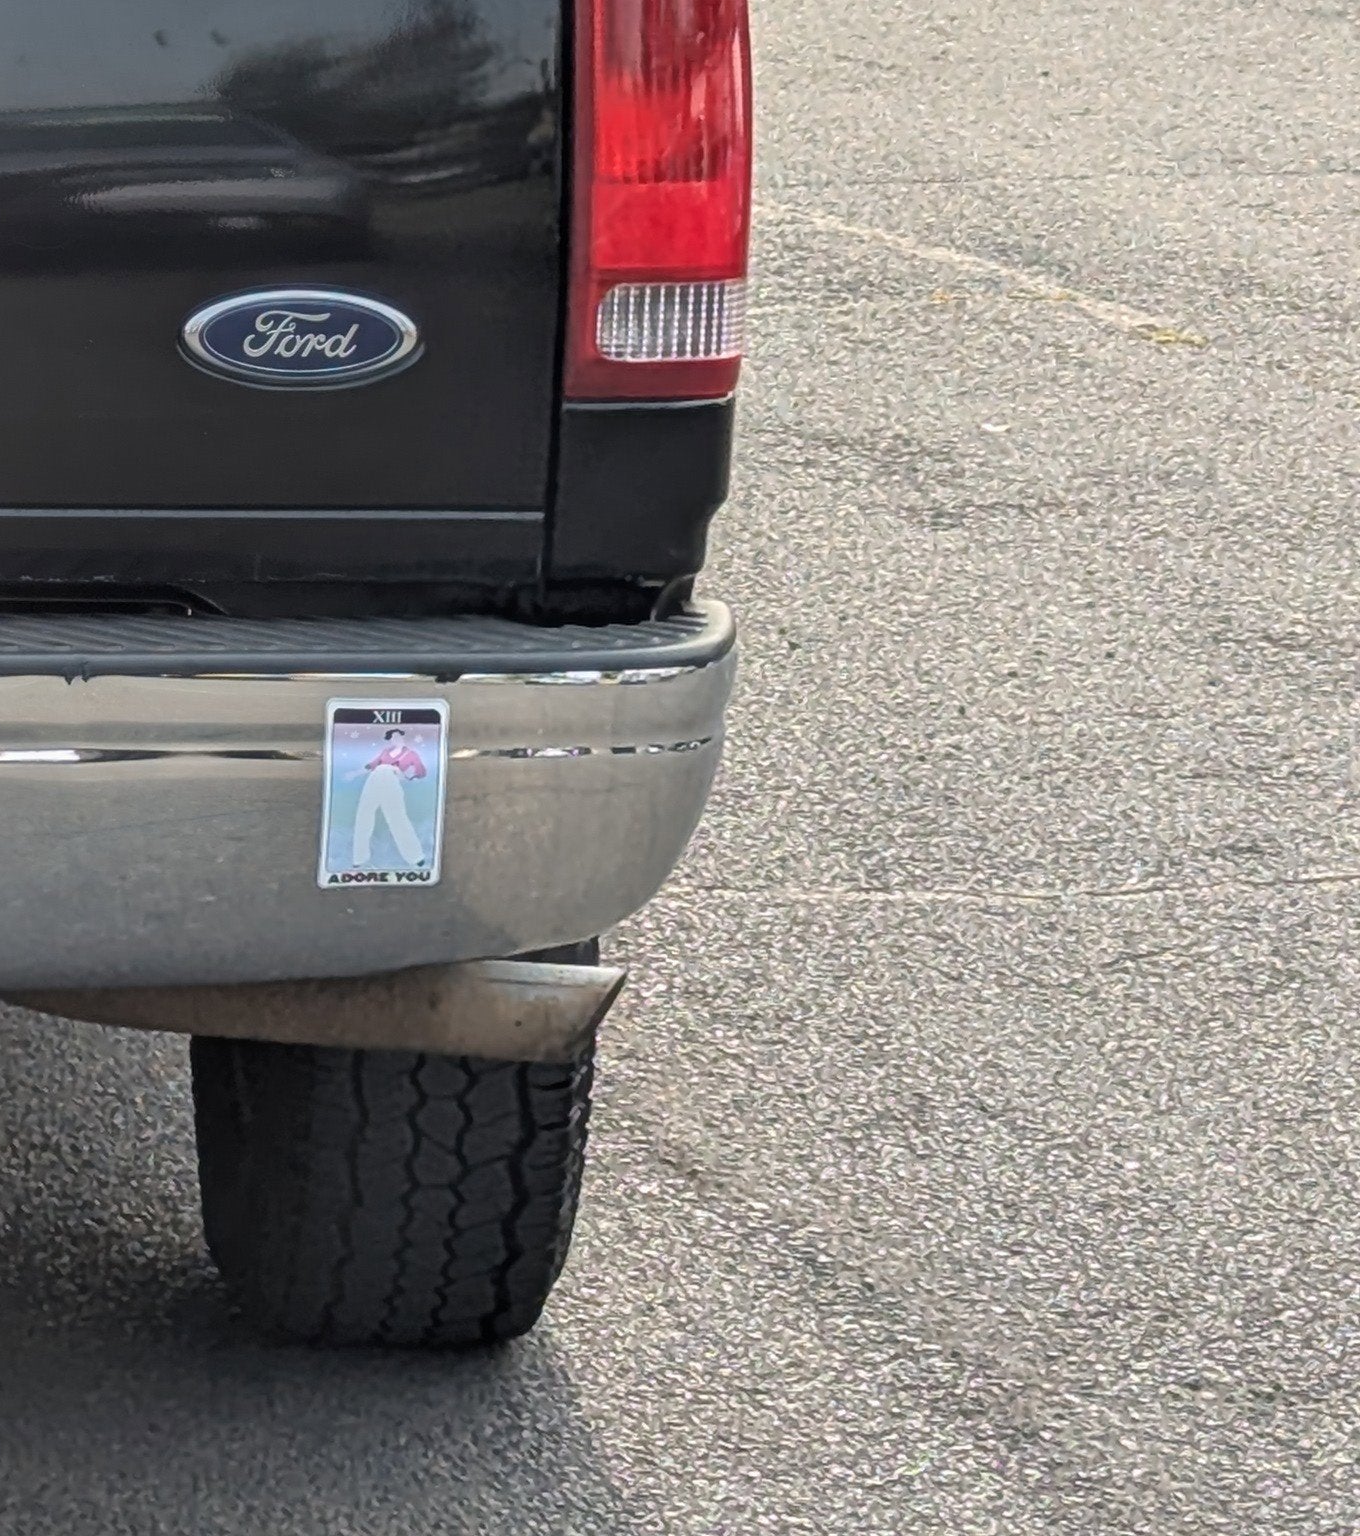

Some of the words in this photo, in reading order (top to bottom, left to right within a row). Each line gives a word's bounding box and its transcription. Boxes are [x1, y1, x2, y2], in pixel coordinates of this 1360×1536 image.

[242, 309, 360, 358] Ford
[373, 710, 401, 723] XIII
[328, 871, 389, 884] ADORE
[395, 871, 431, 882] YOU
